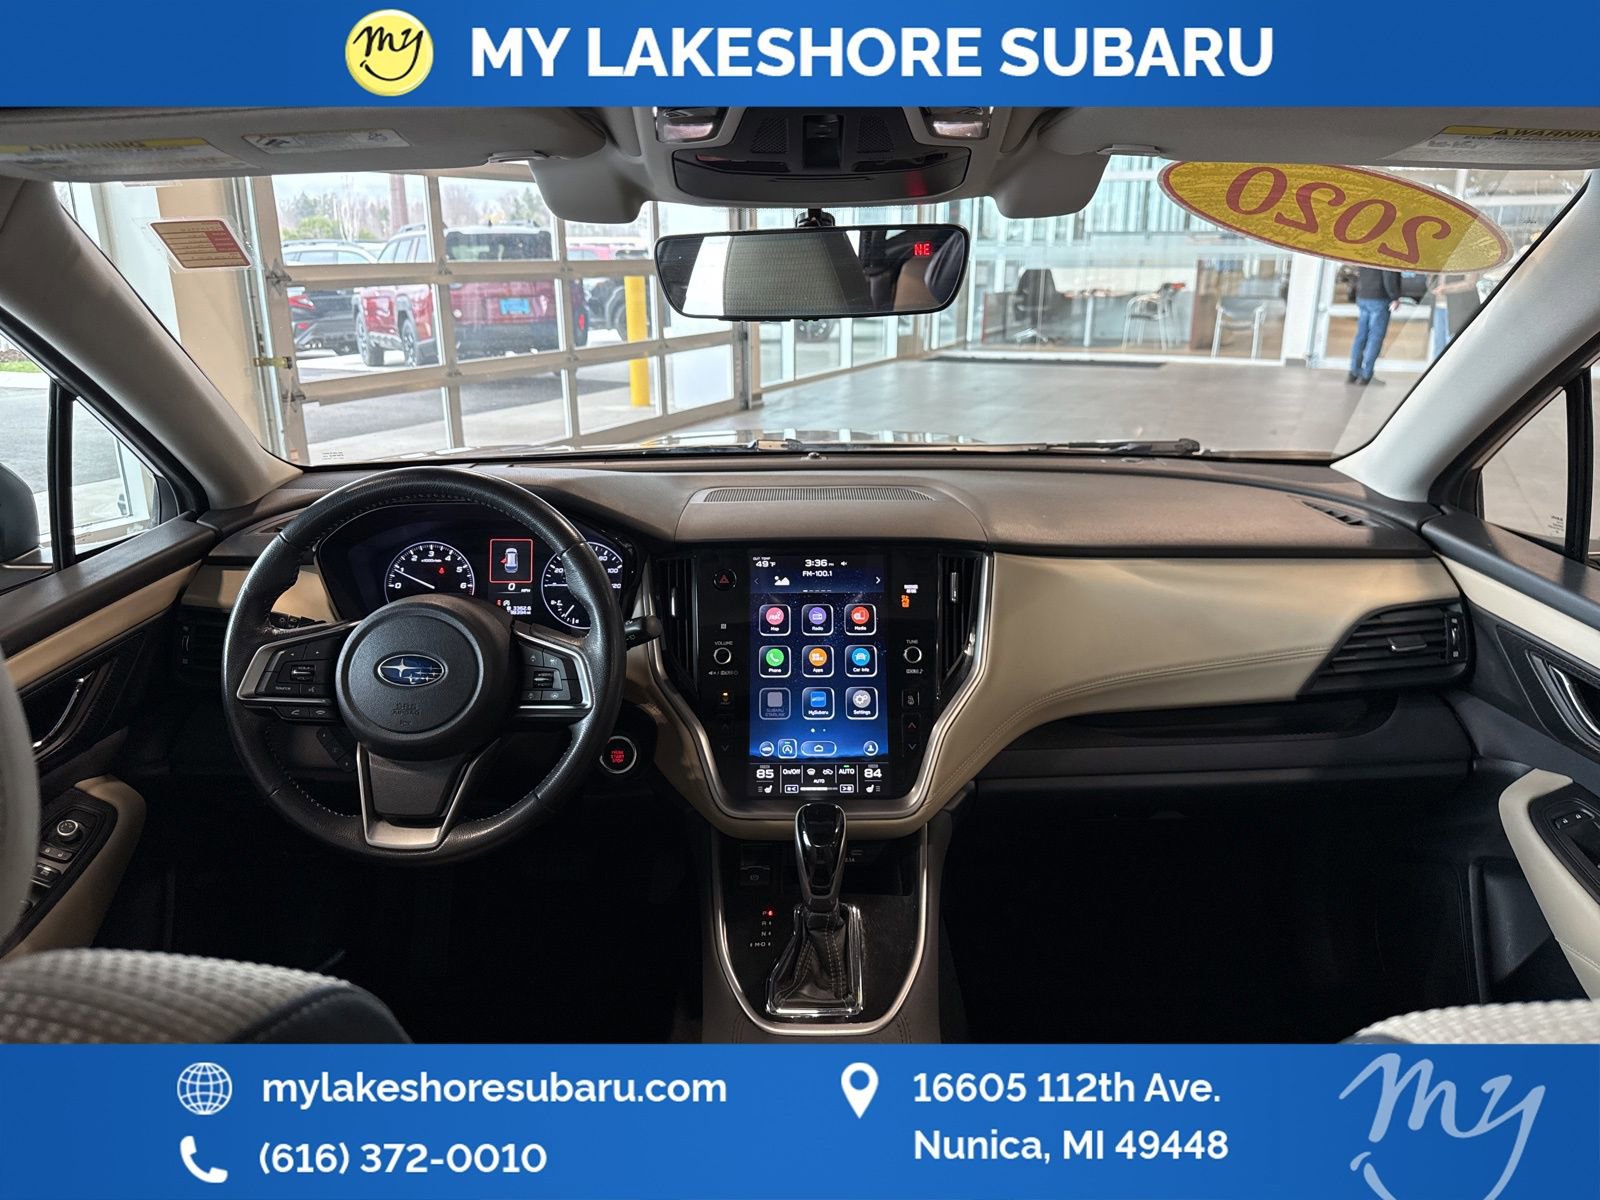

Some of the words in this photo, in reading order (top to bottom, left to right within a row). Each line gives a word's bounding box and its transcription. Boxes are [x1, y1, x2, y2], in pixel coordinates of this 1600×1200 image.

[914, 243, 930, 256] NE
[805, 559, 828, 567] 3:36
[756, 769, 774, 779] 85
[864, 768, 882, 778] 84
